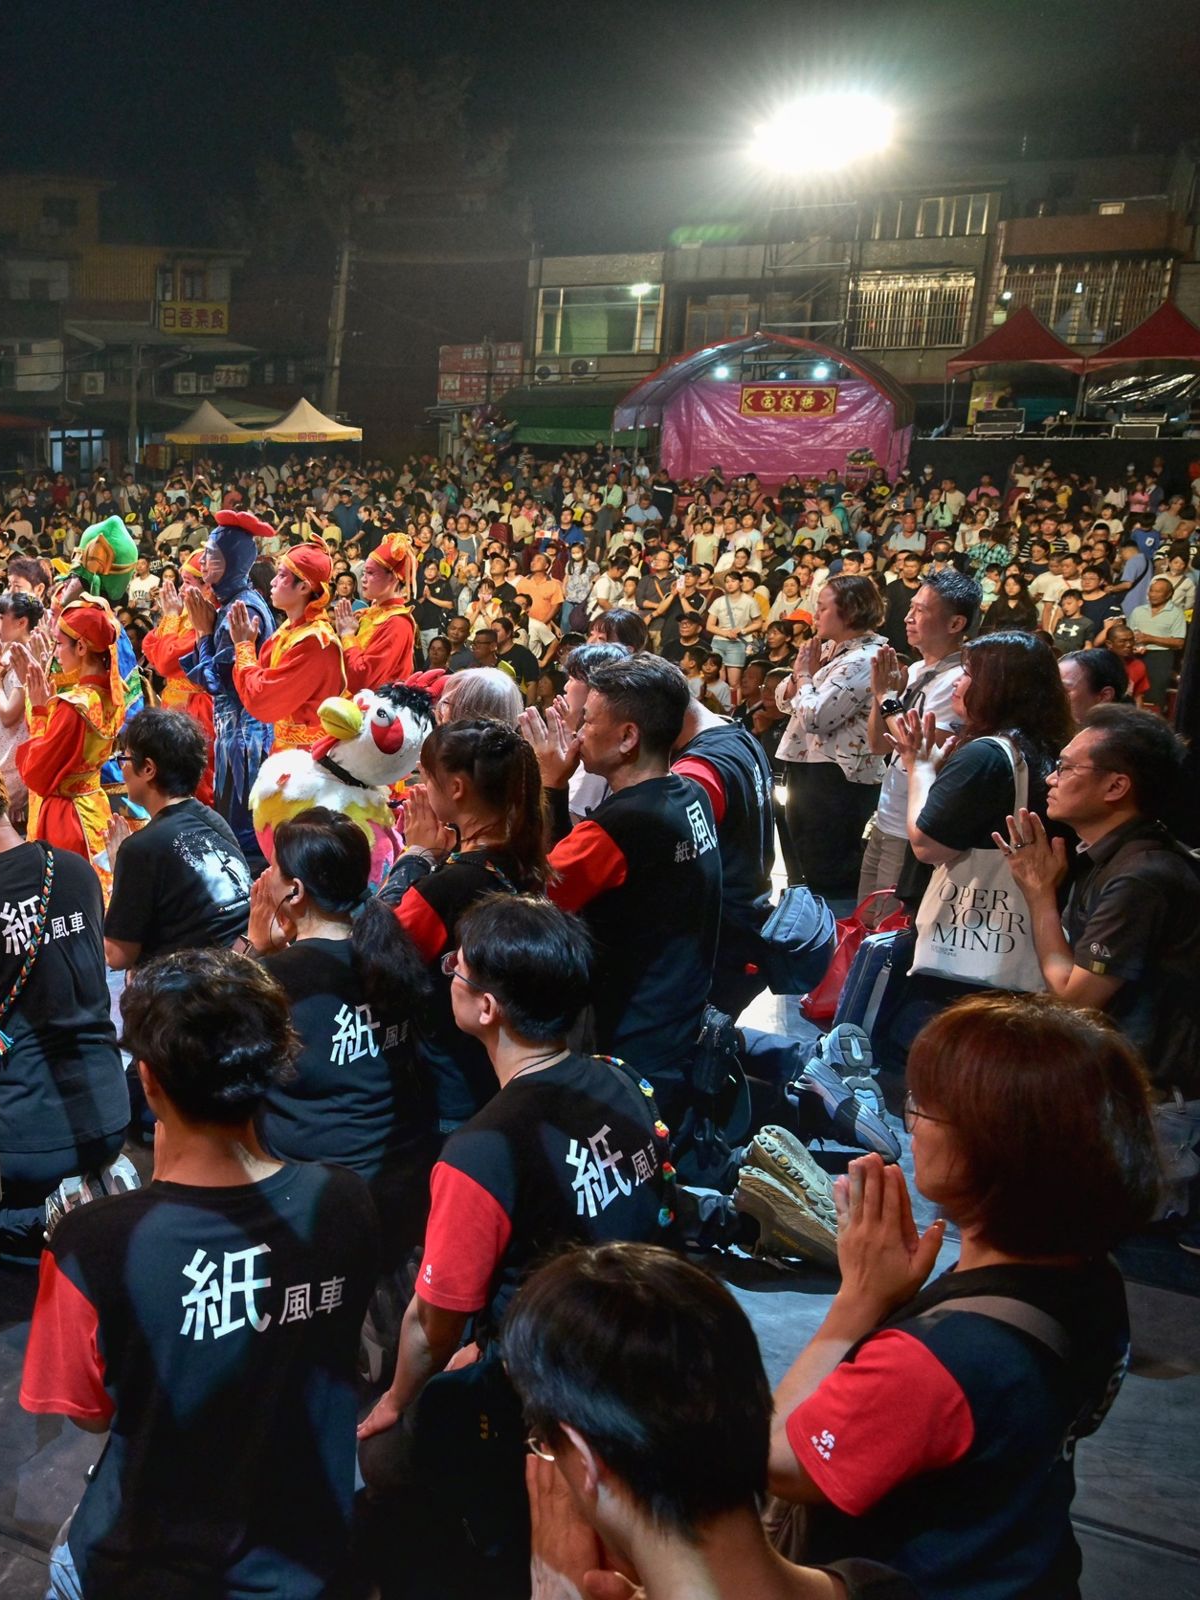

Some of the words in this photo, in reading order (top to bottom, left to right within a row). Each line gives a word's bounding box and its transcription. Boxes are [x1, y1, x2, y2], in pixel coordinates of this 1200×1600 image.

[163, 307, 225, 329] 日香素食
[939, 881, 1009, 911] OPER
[950, 904, 1026, 935] YOUR
[932, 922, 1016, 954] MIND
[179, 1243, 346, 1341] 紙風車
